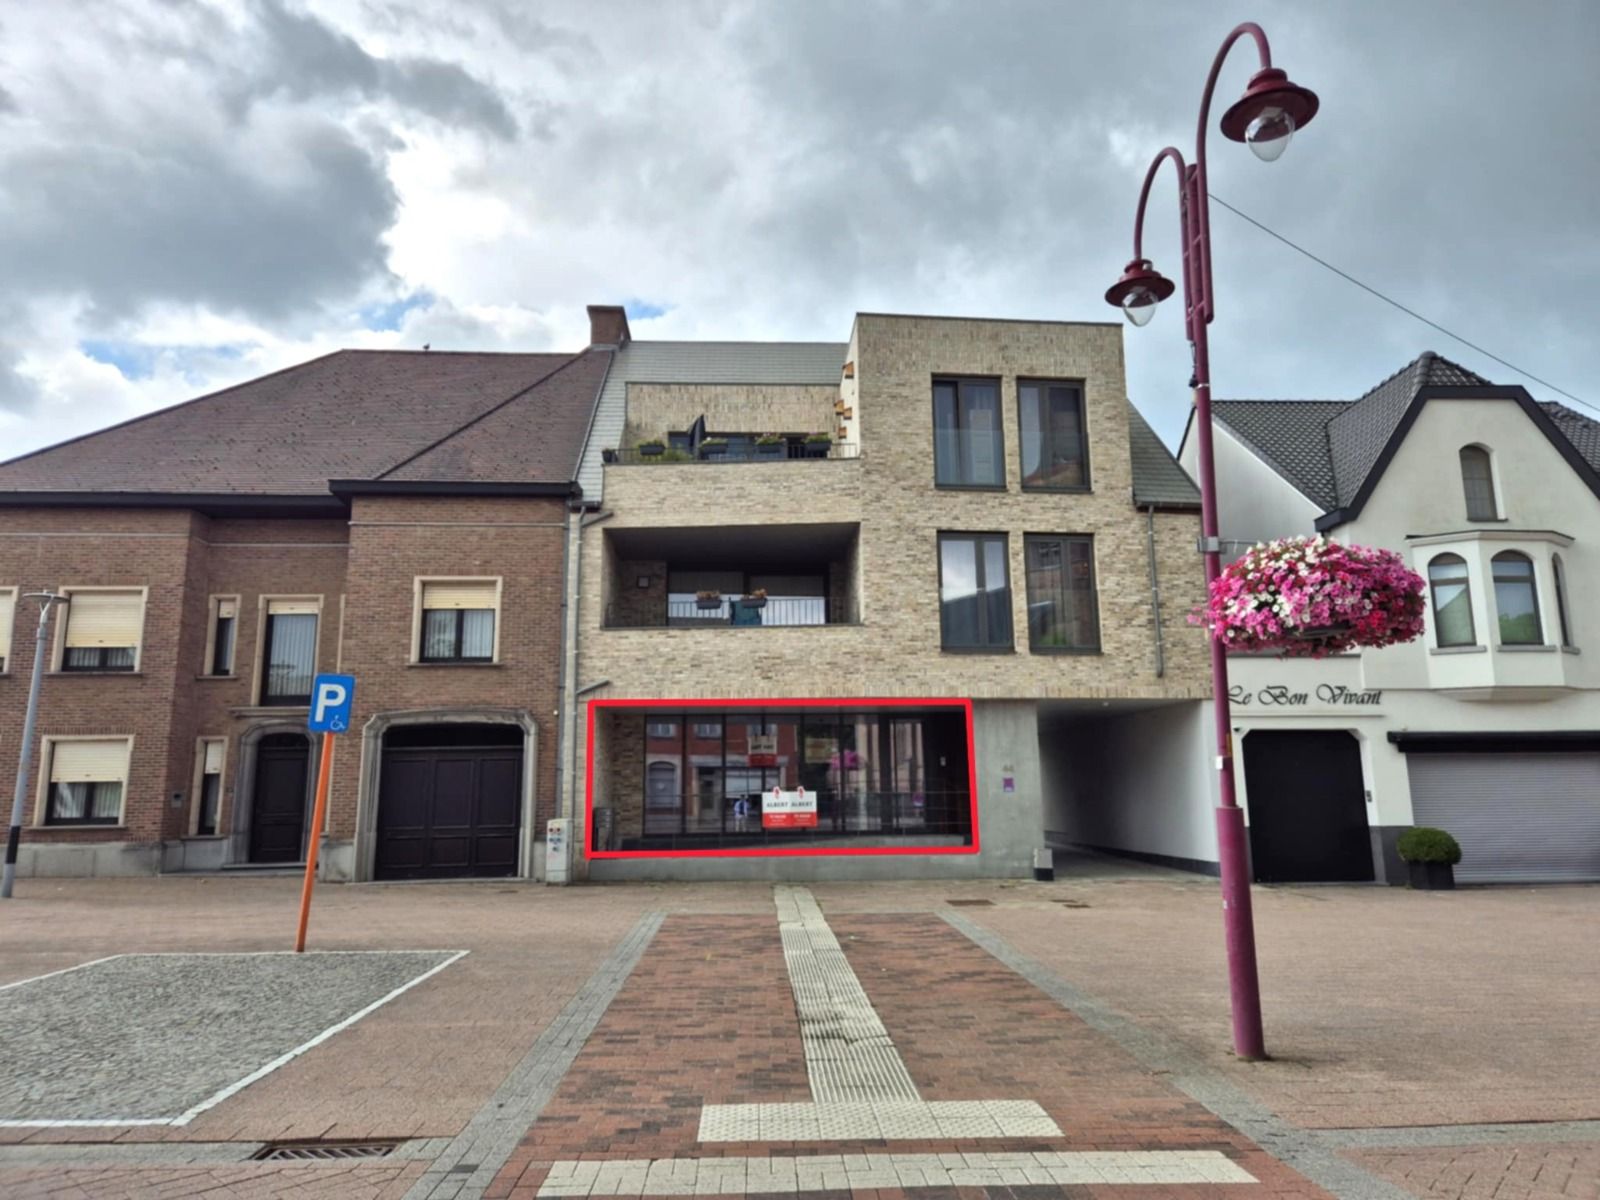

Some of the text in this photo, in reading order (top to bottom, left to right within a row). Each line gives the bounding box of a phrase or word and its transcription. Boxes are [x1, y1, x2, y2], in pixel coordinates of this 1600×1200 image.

[315, 683, 346, 722] P
[1228, 683, 1383, 706] Le Bon Vivant
